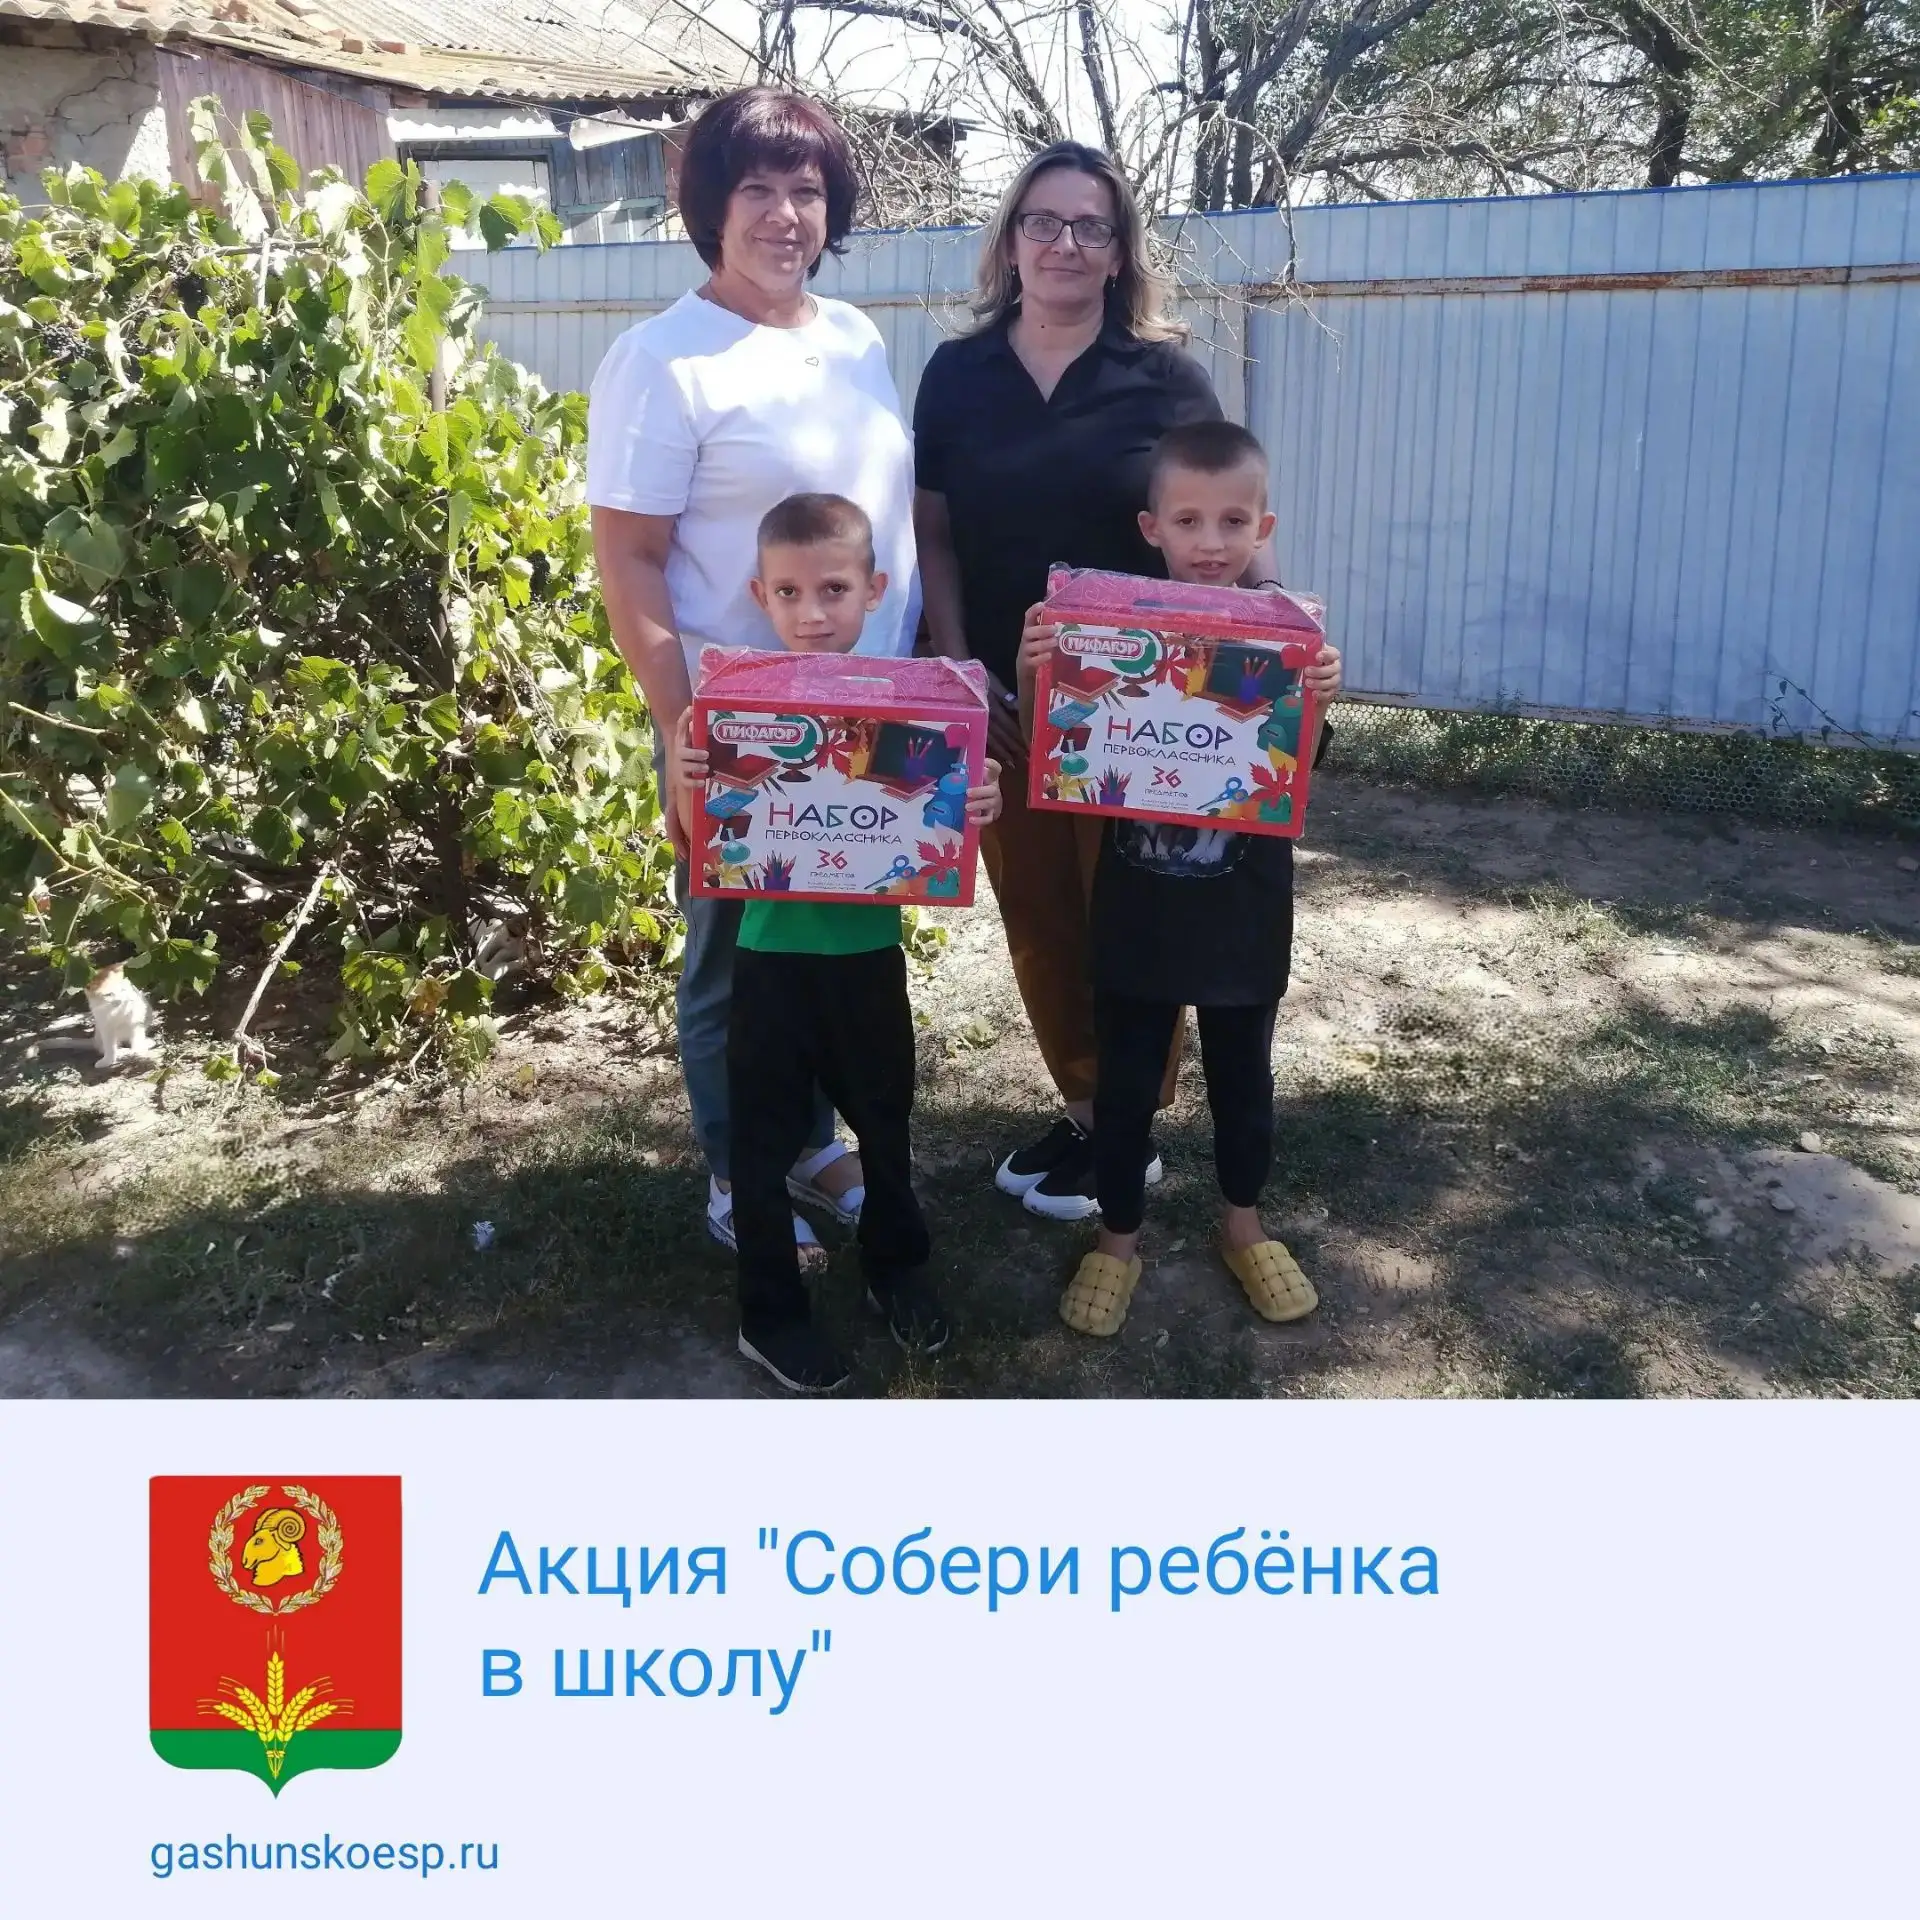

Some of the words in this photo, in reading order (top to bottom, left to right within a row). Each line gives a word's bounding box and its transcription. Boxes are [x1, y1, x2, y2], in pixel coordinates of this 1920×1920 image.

[1066, 636, 1139, 655] ПИФАГОР
[721, 724, 798, 741] ПИФАГОР
[1106, 715, 1233, 750] НАБОР
[1103, 743, 1236, 766] ПЕРВОКЛАССНИКА
[1150, 765, 1182, 788] 36
[768, 802, 899, 830] НАБОР
[765, 829, 902, 845] ПЕРВОКЛАССНИКА
[816, 849, 848, 870] 36
